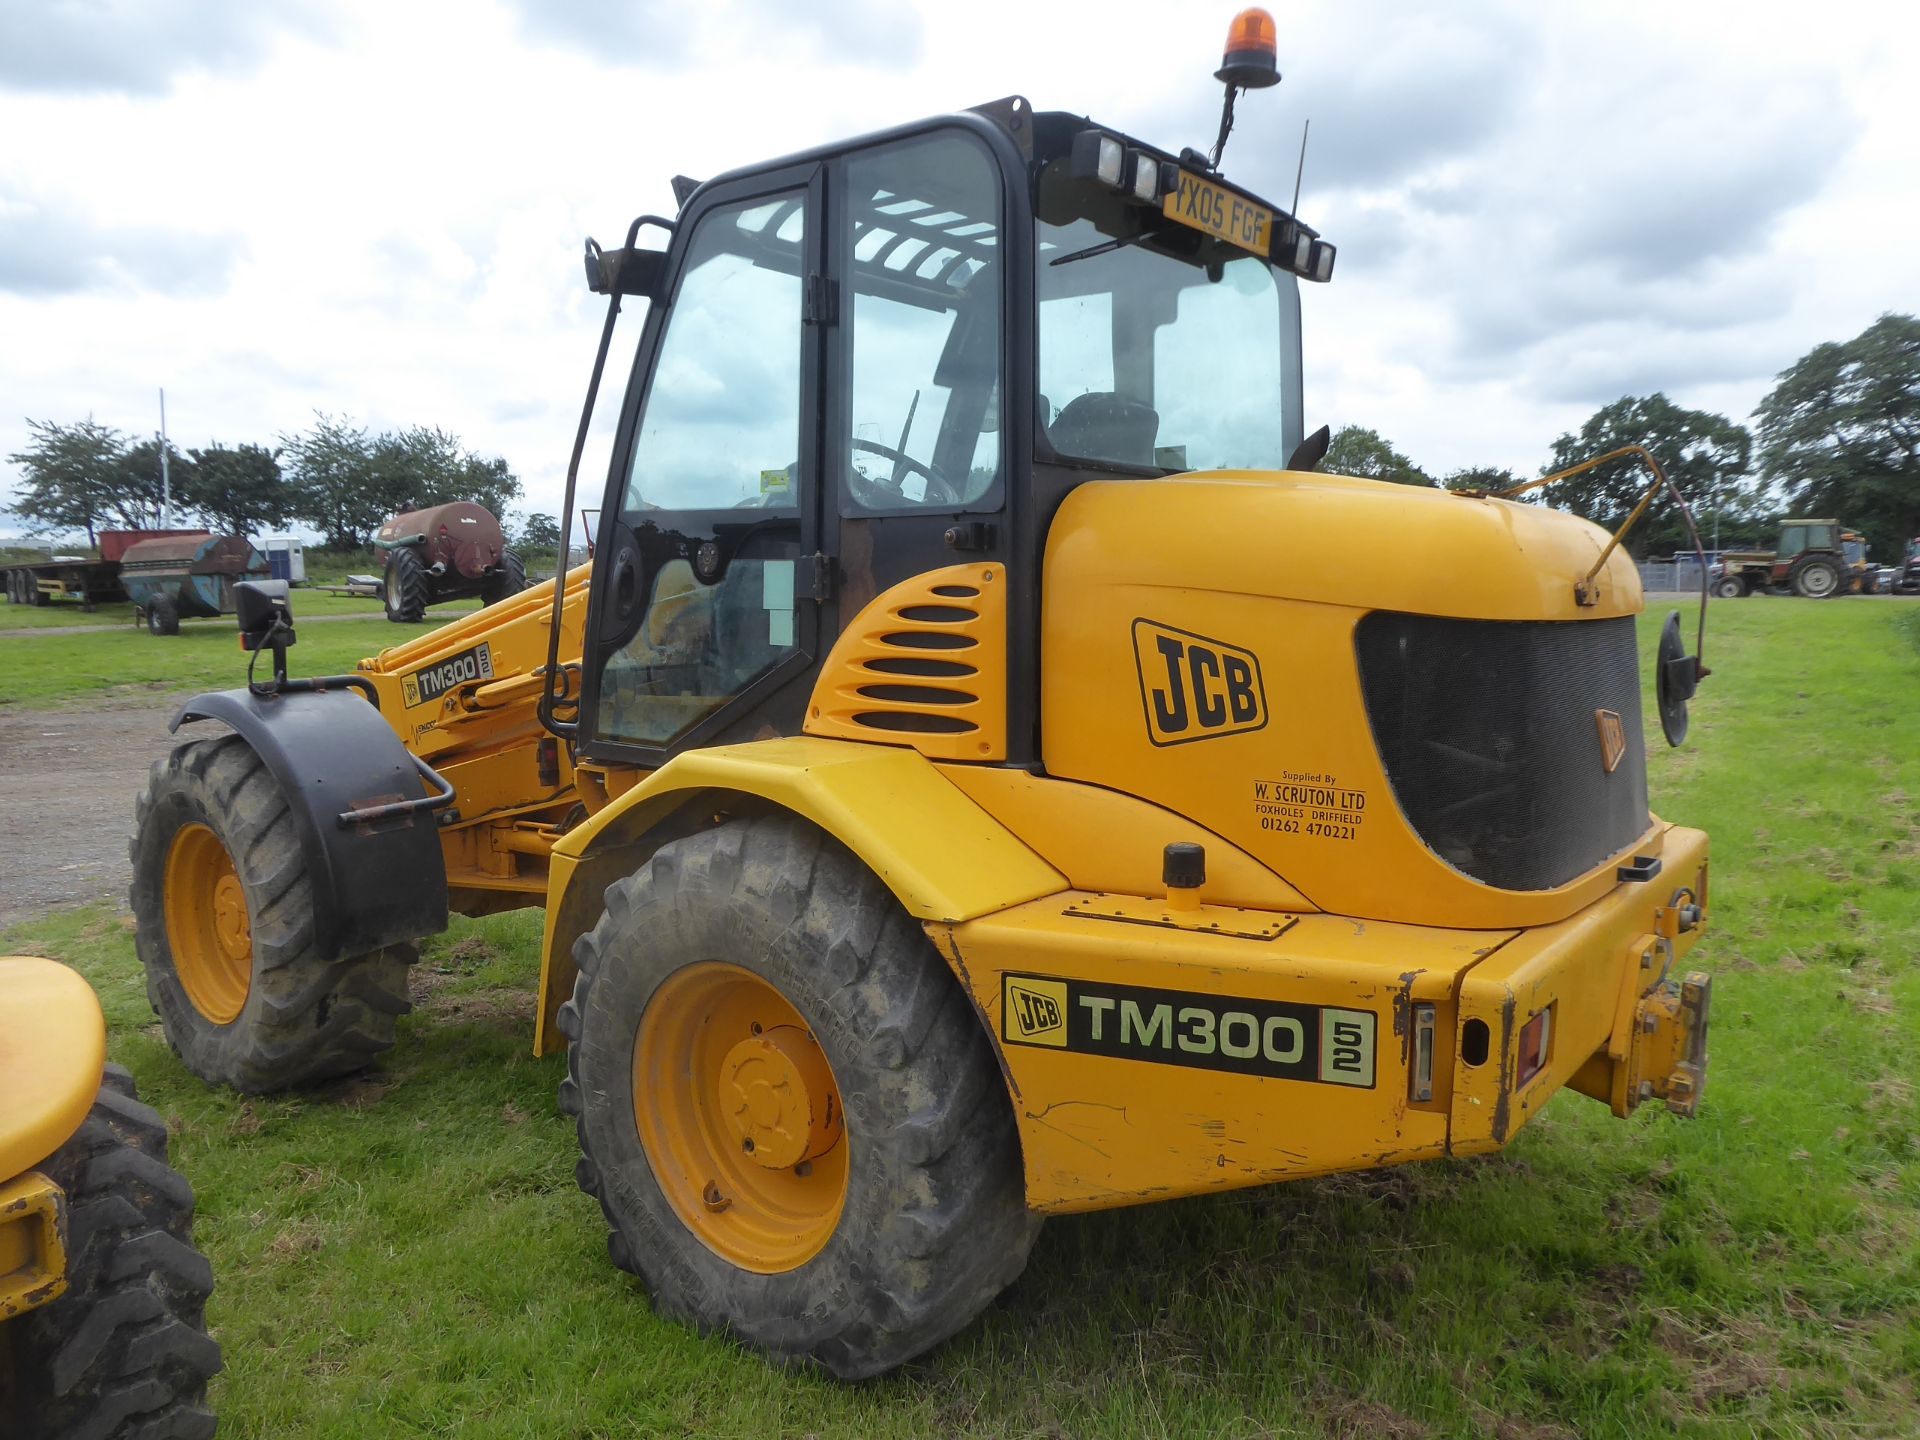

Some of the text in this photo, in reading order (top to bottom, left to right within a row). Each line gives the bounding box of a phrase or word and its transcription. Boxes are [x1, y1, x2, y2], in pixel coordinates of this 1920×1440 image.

[1175, 177, 1224, 229] YX05
[420, 656, 475, 695] TM300
[1151, 633, 1258, 733] JCB
[1282, 770, 1336, 785] Supplied By
[1255, 782, 1365, 810] W. SCRUTON LTD
[1255, 804, 1362, 824] FOXHOLES DRIFFIELD
[1261, 817, 1355, 840] 01262 470221
[1020, 992, 1058, 1031] JCB
[1079, 995, 1304, 1064] TM300
